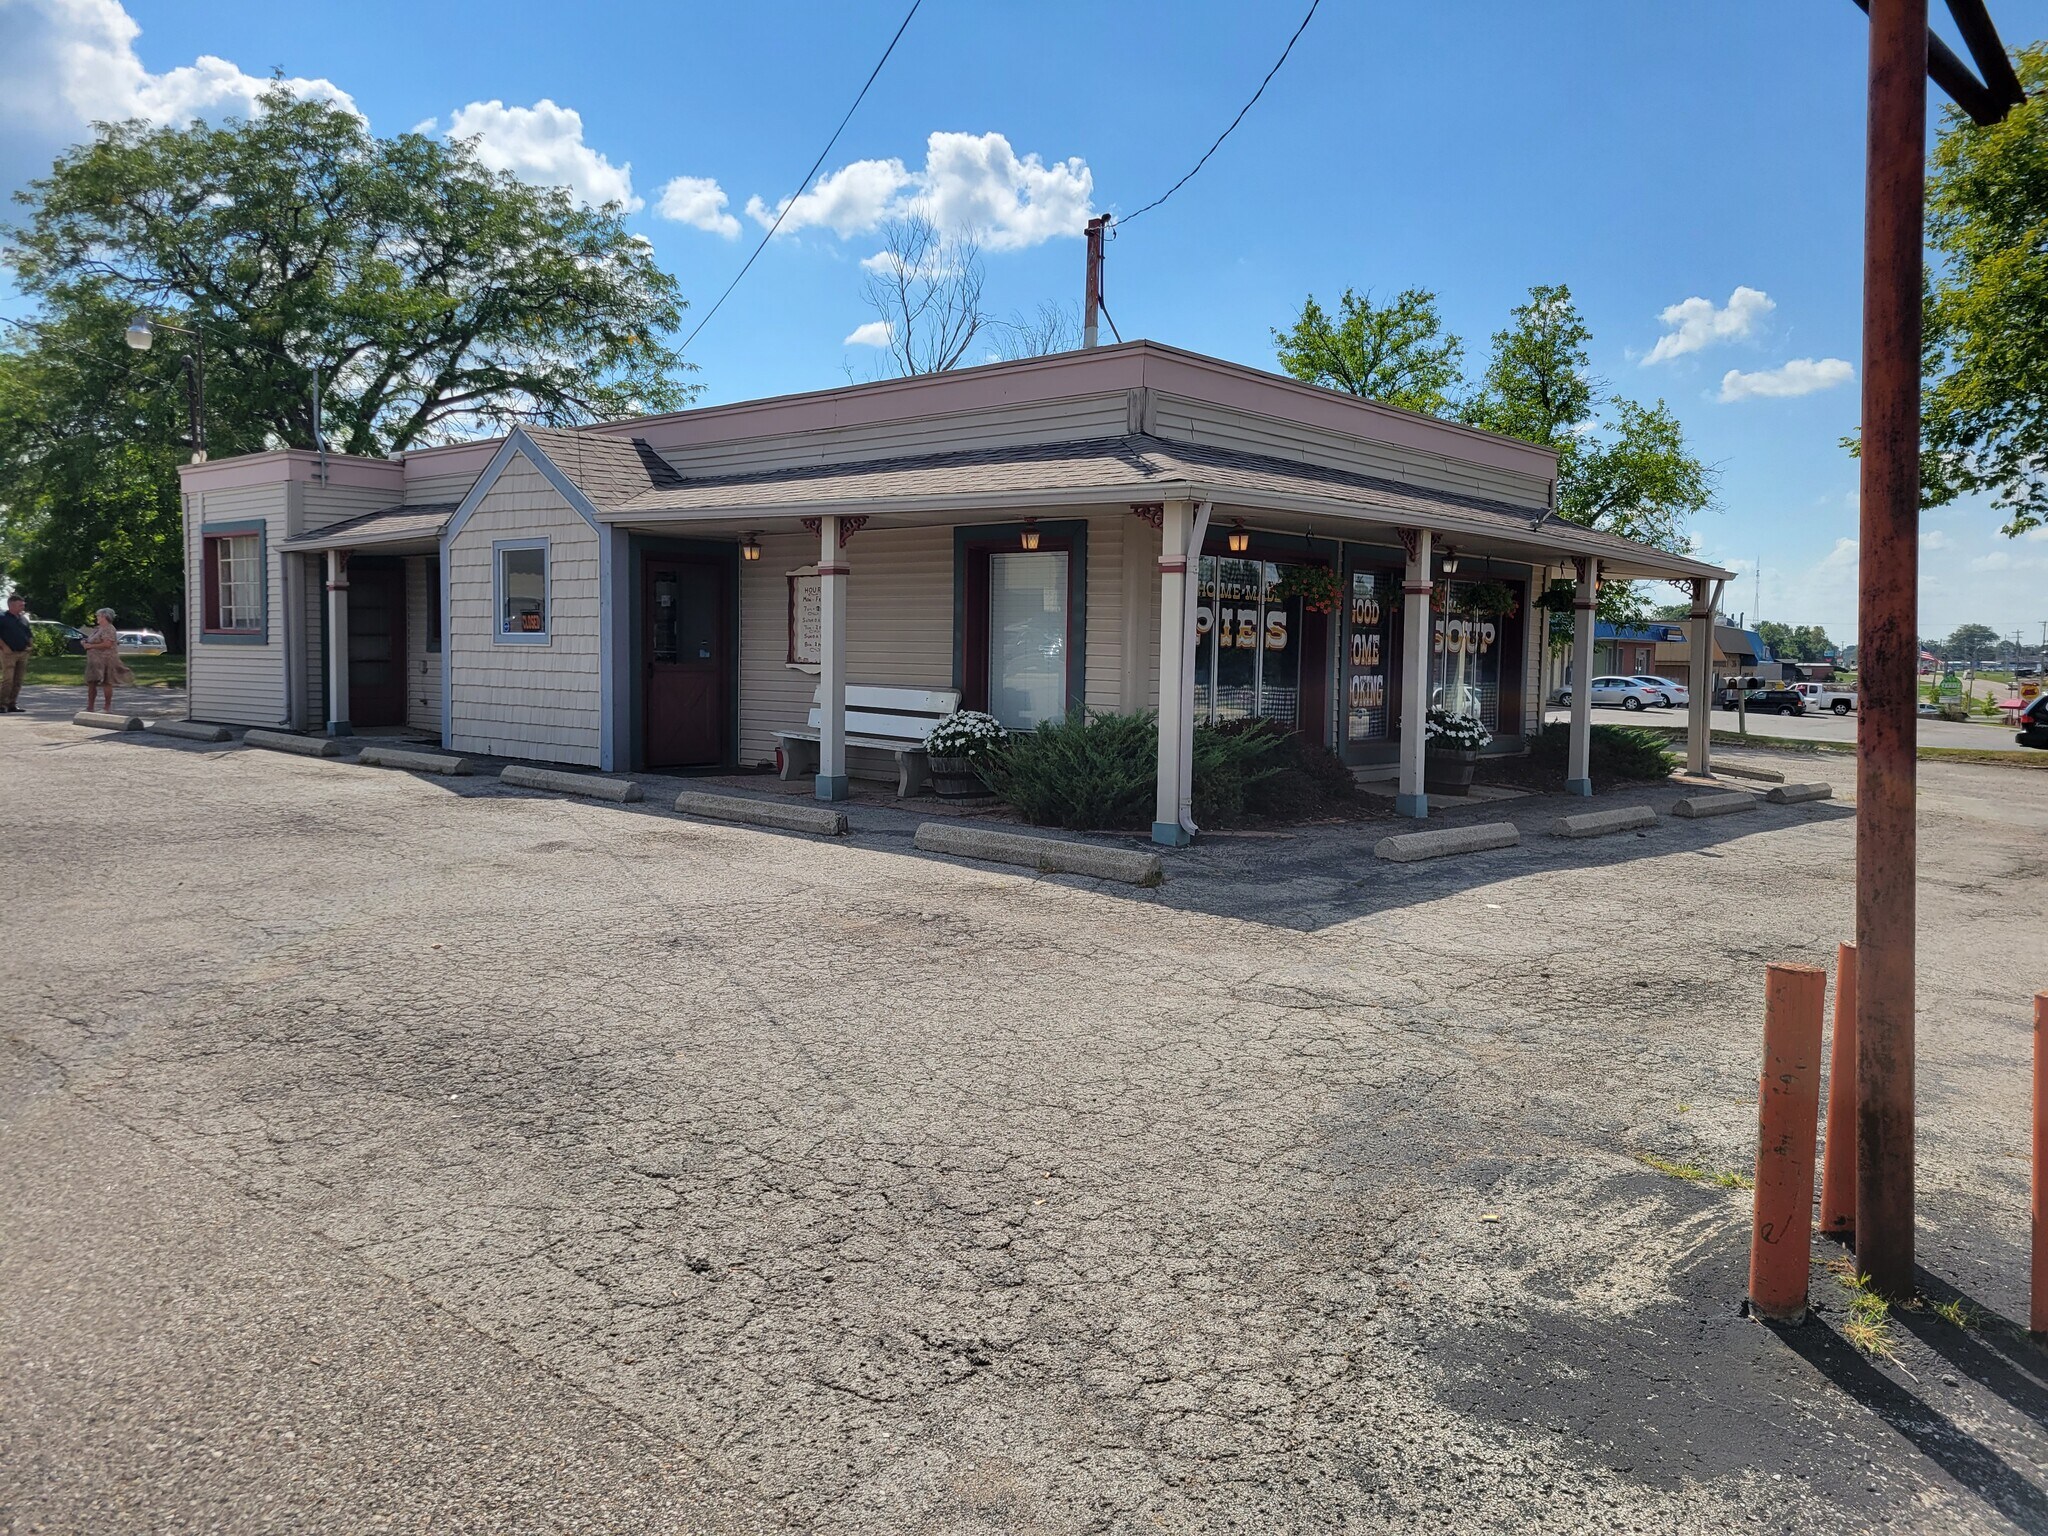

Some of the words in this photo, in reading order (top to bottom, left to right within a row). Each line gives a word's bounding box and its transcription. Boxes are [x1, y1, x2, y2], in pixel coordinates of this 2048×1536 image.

[1196, 606, 1288, 651] PIES
[1434, 620, 1496, 653] SOUP
[1351, 634, 1380, 666] OME
[1349, 675, 1384, 707] OKING
